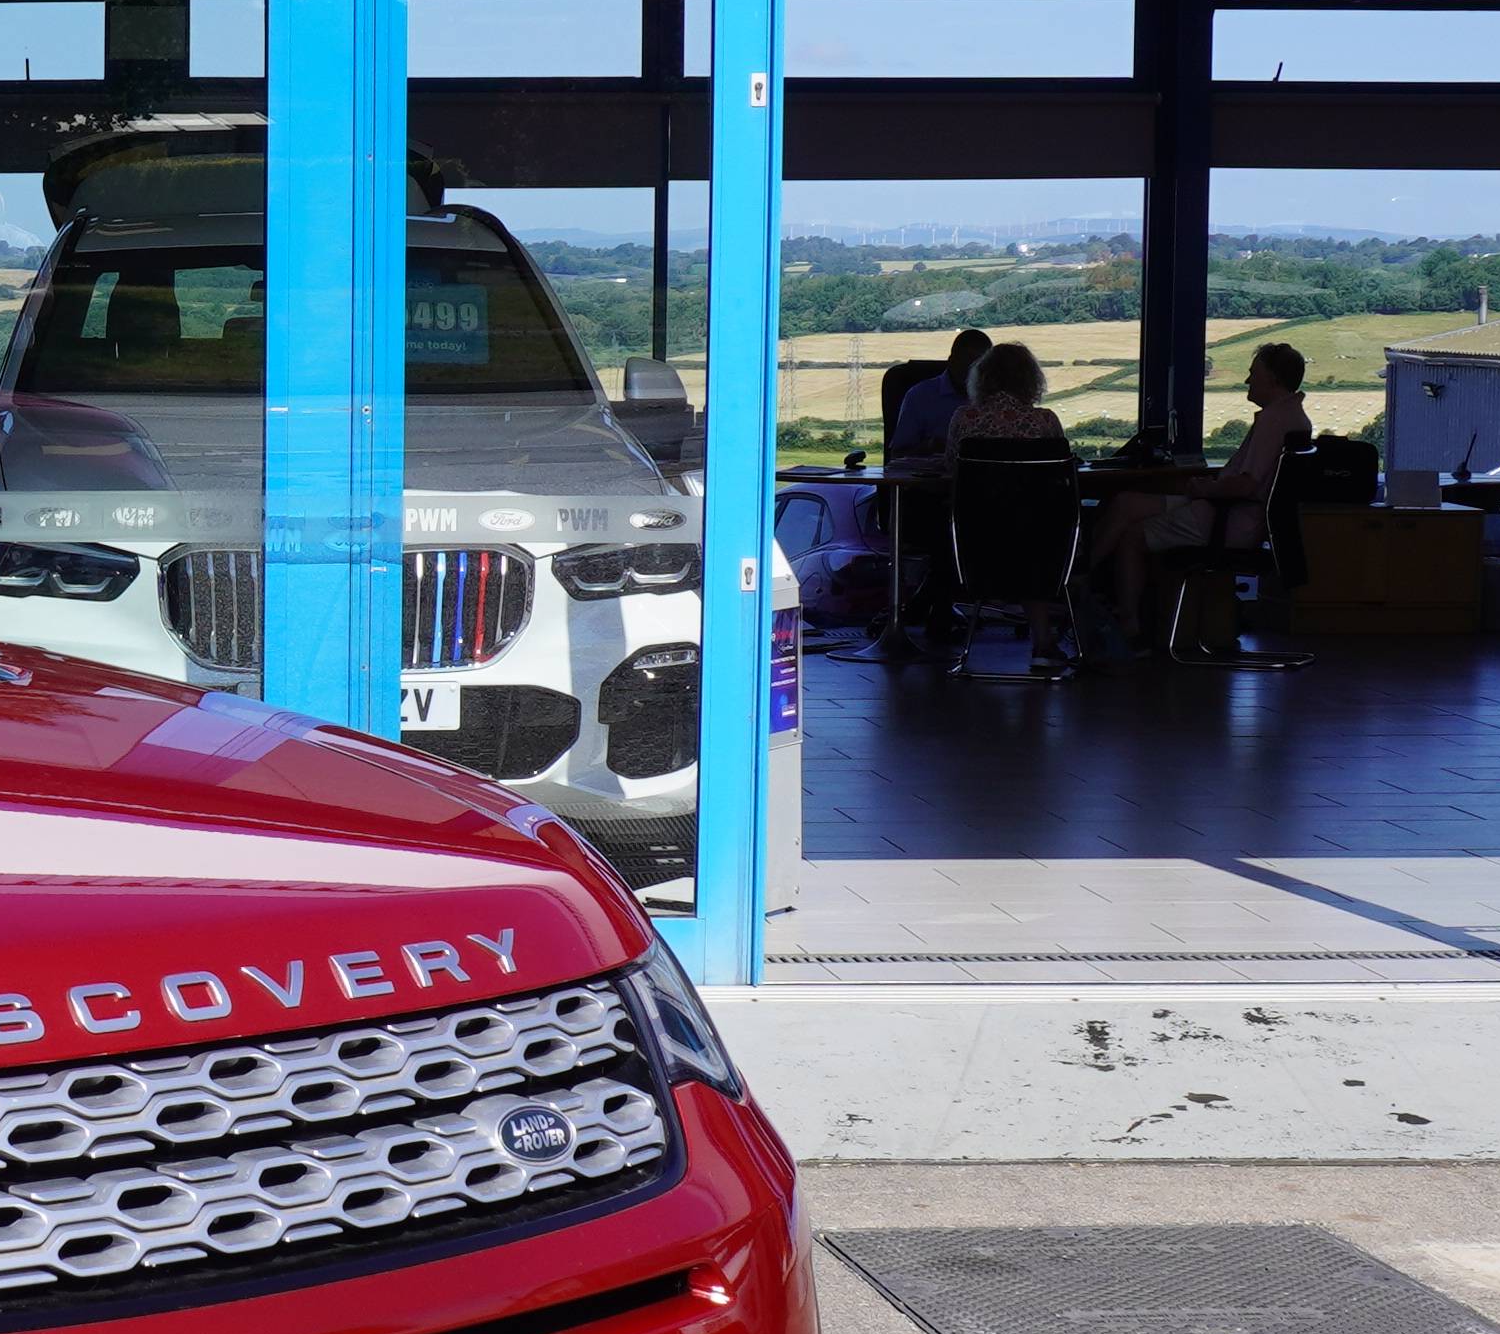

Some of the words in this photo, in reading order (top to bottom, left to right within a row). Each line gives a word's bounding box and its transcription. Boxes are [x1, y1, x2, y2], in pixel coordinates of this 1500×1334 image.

[405, 301, 479, 332] 499
[404, 508, 458, 532] PWM
[484, 510, 528, 529] Ford
[556, 508, 609, 532] PWM
[511, 1115, 548, 1137] LAND
[523, 1128, 567, 1152] ROVER
